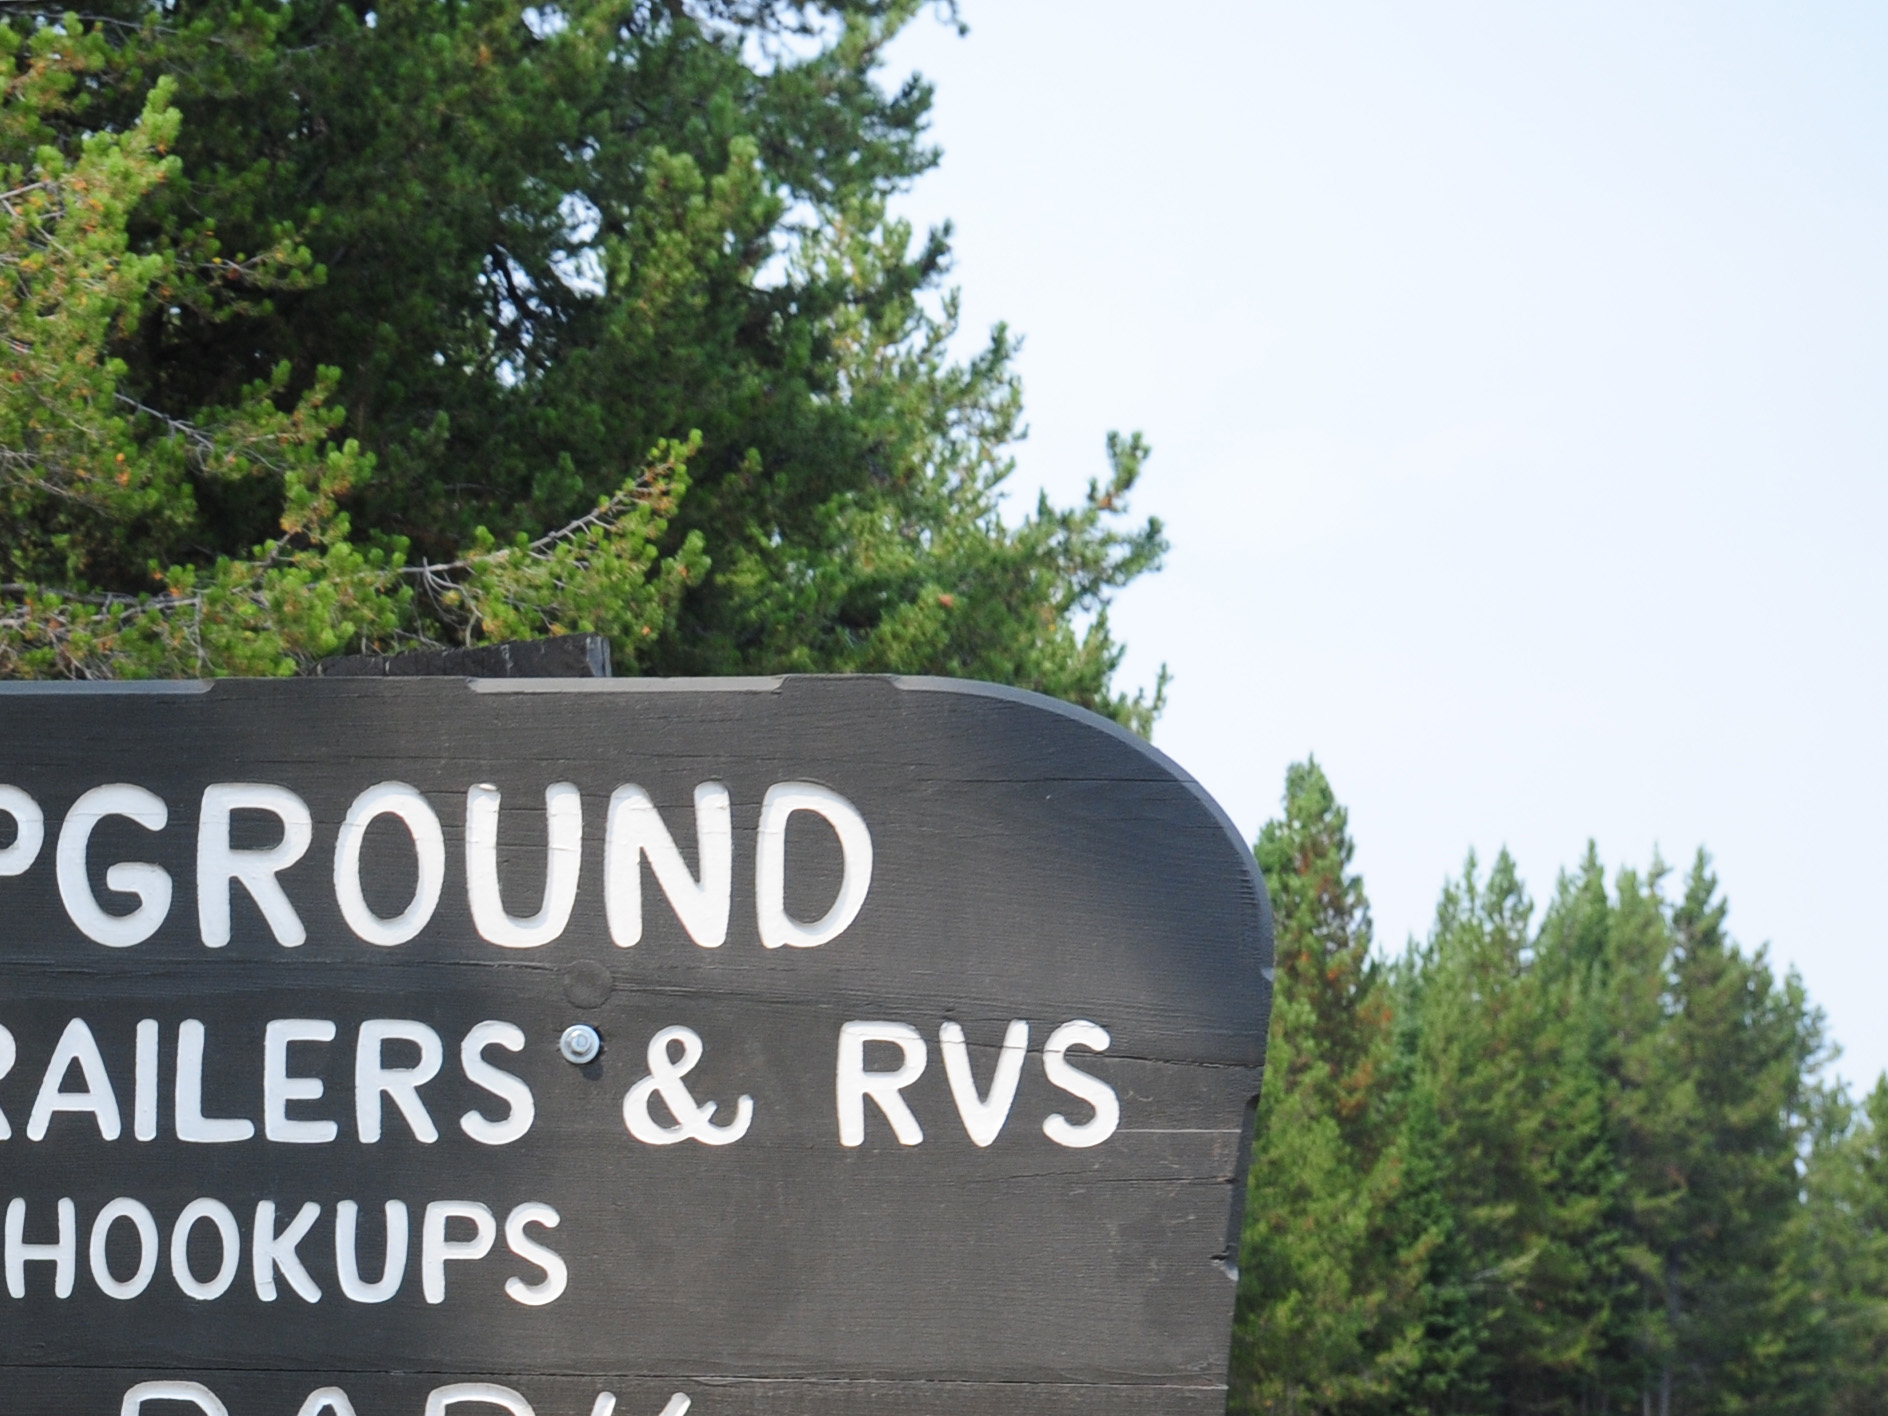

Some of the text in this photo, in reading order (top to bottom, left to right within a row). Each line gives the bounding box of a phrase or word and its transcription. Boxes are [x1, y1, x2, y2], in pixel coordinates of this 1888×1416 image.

[621, 1024, 754, 1146] &
[835, 1018, 1121, 1149] RVS
[4, 1196, 569, 1307] HOOKUPS
